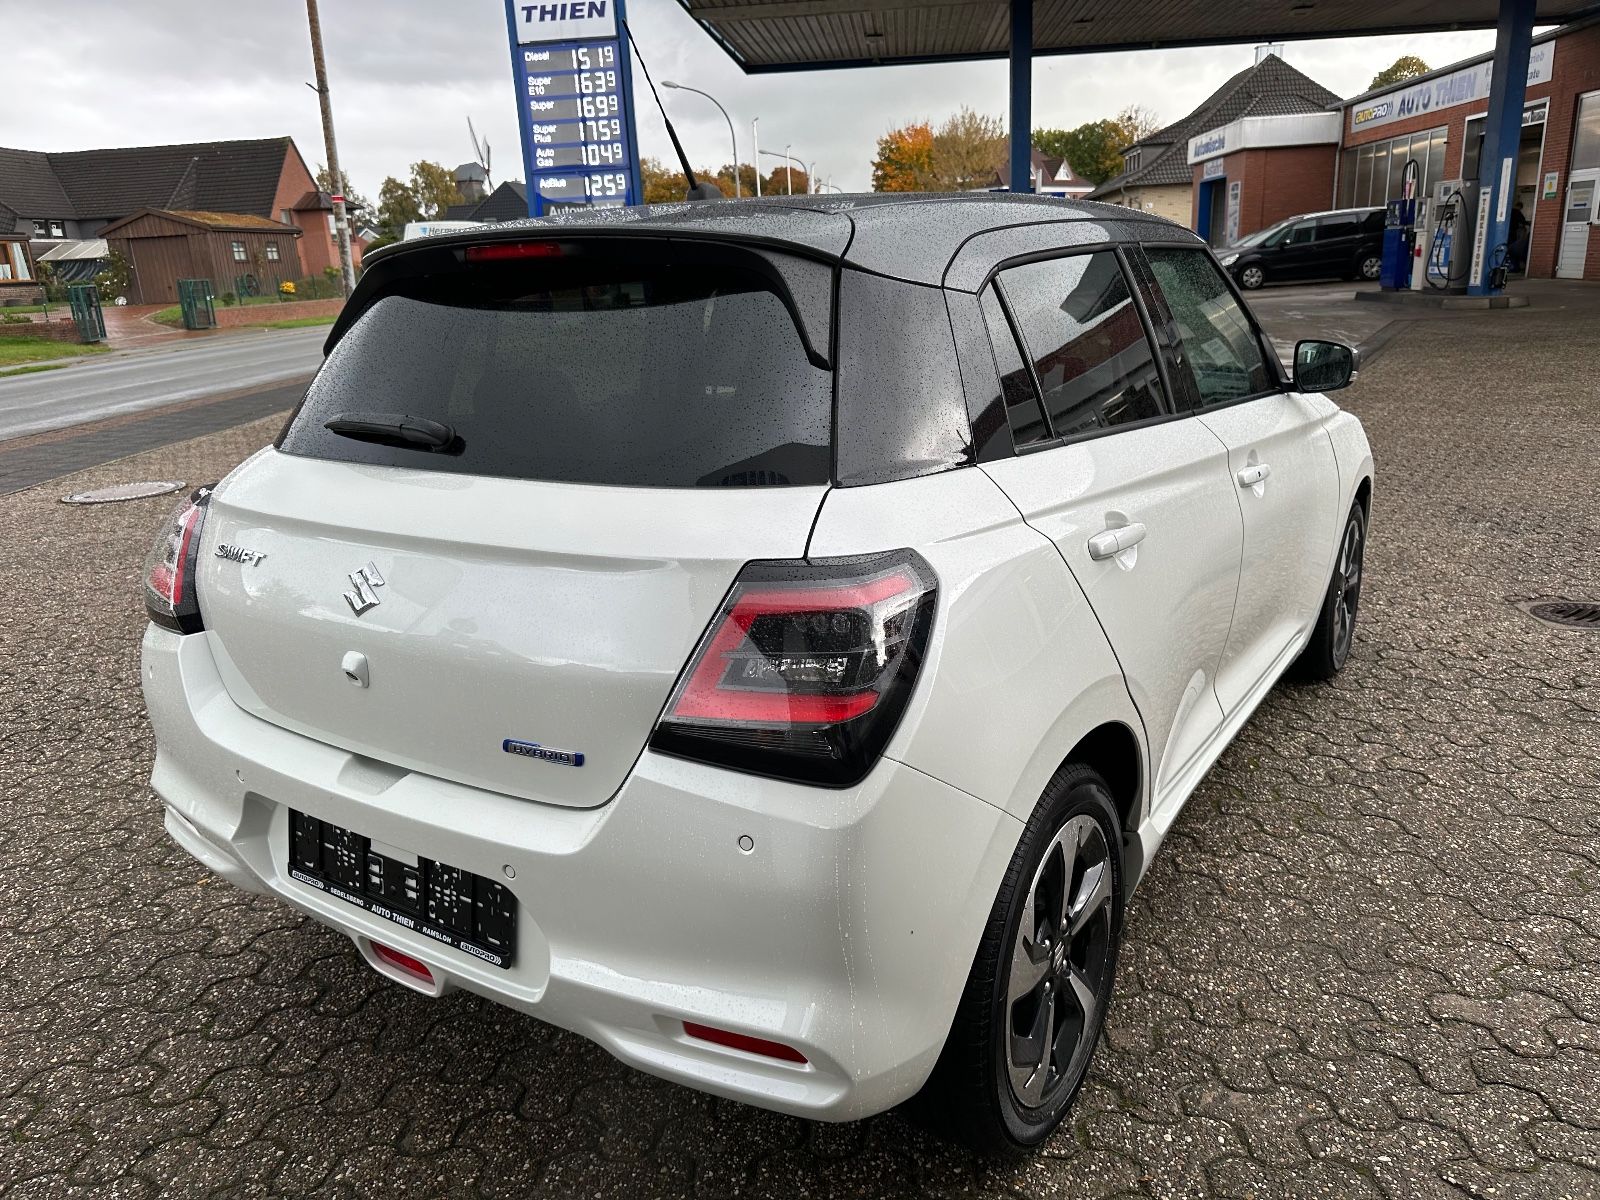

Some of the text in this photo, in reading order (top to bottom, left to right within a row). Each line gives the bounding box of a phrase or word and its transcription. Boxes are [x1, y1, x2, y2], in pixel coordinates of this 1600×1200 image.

[521, 1, 606, 23] THIEN
[524, 51, 550, 62] Diesel
[527, 76, 552, 86] Super
[528, 86, 545, 96] E10
[1398, 88, 1431, 117] AUTO
[1435, 73, 1477, 106] THIEN
[530, 100, 555, 111] Super
[532, 124, 557, 135] Super
[535, 148, 555, 158] Auto
[536, 157, 554, 167] Gas
[214, 543, 267, 567] SWIFT
[511, 744, 571, 764] HYBRID
[371, 904, 392, 922] AUTO
[392, 911, 415, 929] THIEN
[422, 925, 452, 944] RAMSLOH
